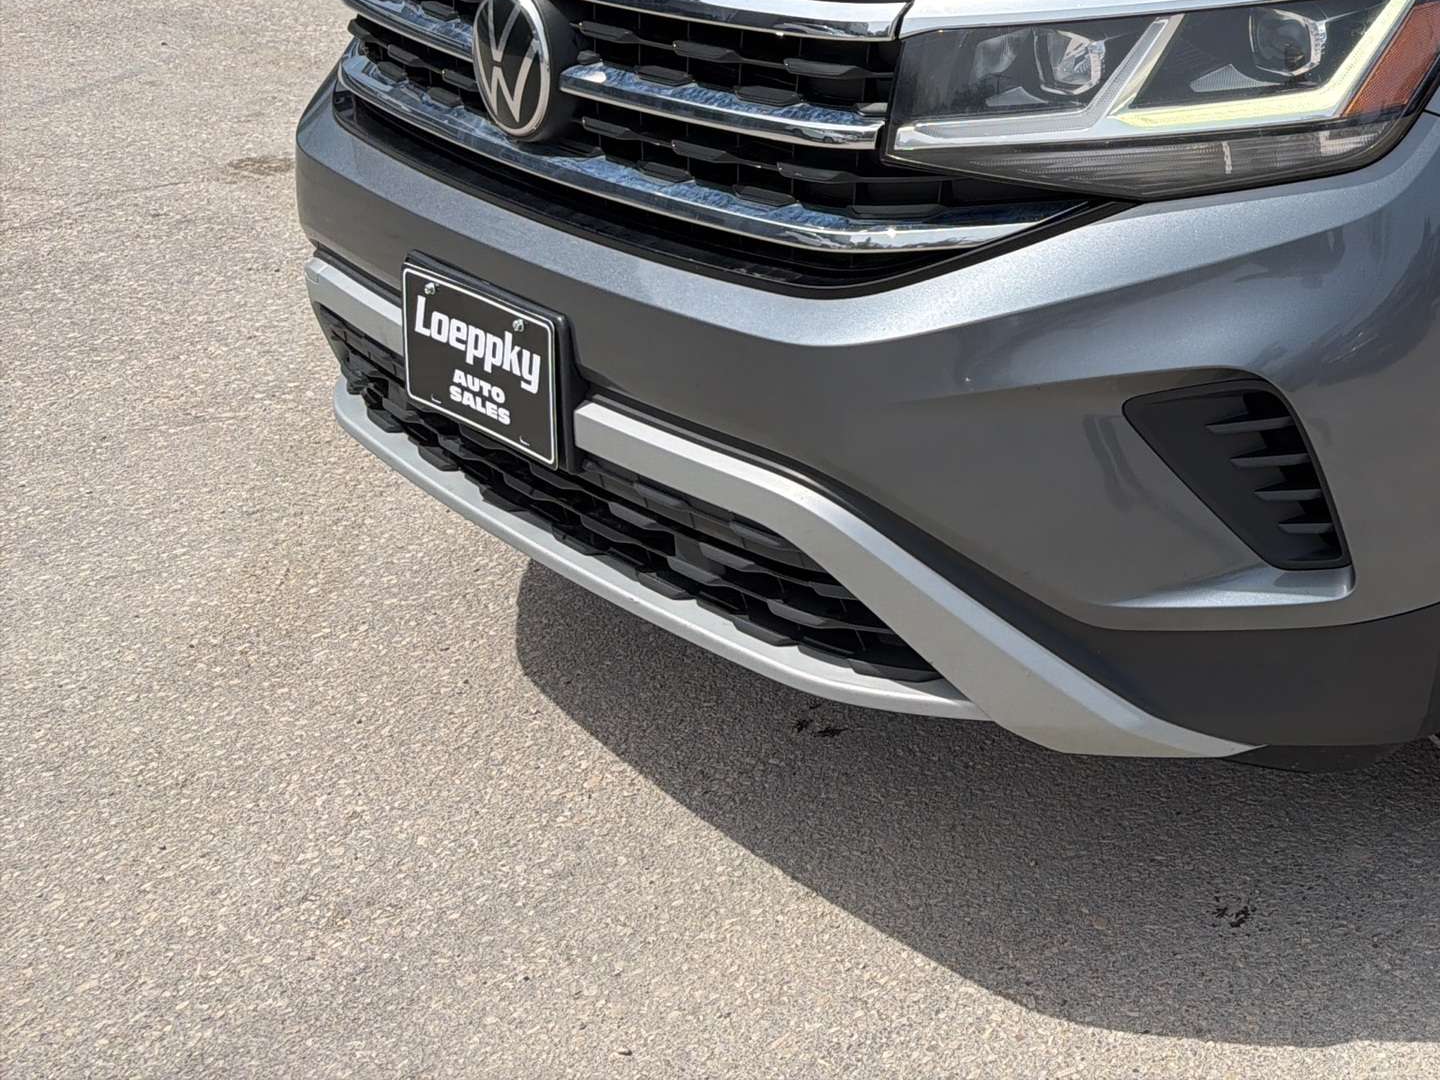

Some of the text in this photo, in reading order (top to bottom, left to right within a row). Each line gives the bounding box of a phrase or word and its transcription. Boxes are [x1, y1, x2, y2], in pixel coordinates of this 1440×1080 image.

[414, 295, 541, 395] Loeppky
[450, 386, 511, 426] SALES
[453, 369, 506, 404] AUTO
